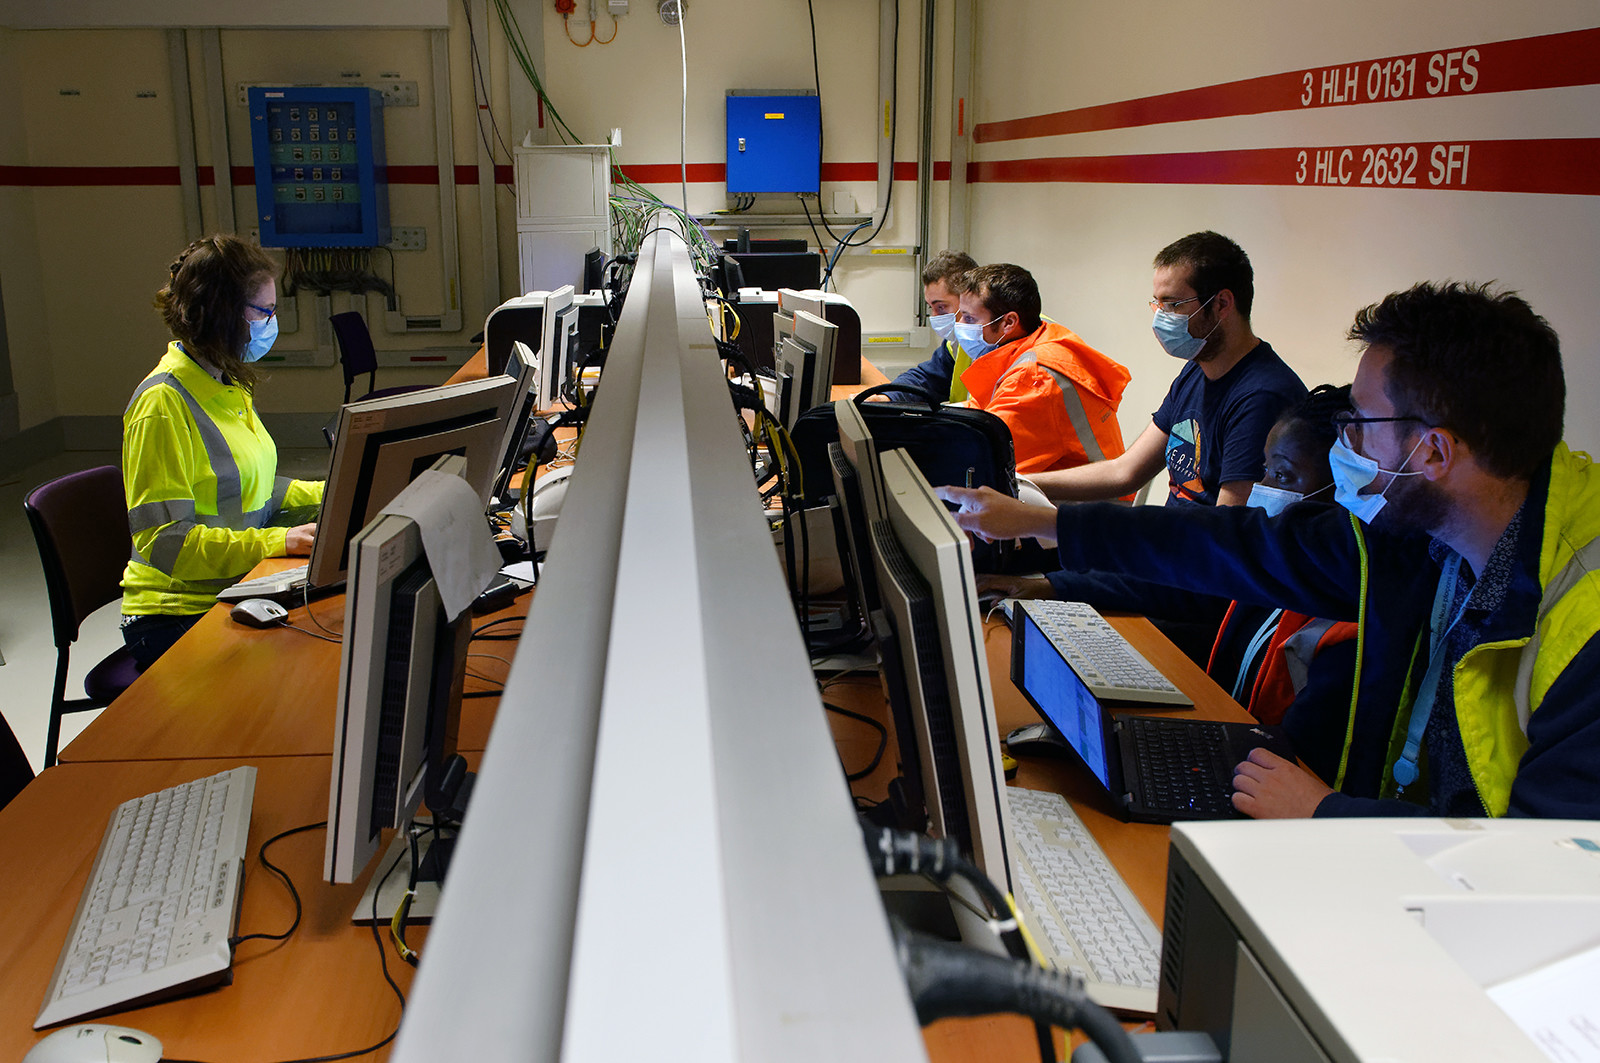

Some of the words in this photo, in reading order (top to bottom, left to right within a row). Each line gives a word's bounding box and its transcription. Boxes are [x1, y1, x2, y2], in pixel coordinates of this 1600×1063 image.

[1301, 72, 1314, 106] 3
[1320, 66, 1359, 104] HLH
[1366, 58, 1417, 100] 0131
[1426, 49, 1480, 95] SFS
[1295, 150, 1308, 184] 3
[1314, 149, 1353, 185] HLC
[1360, 146, 1419, 185] 2632
[1428, 144, 1470, 186] SFI
